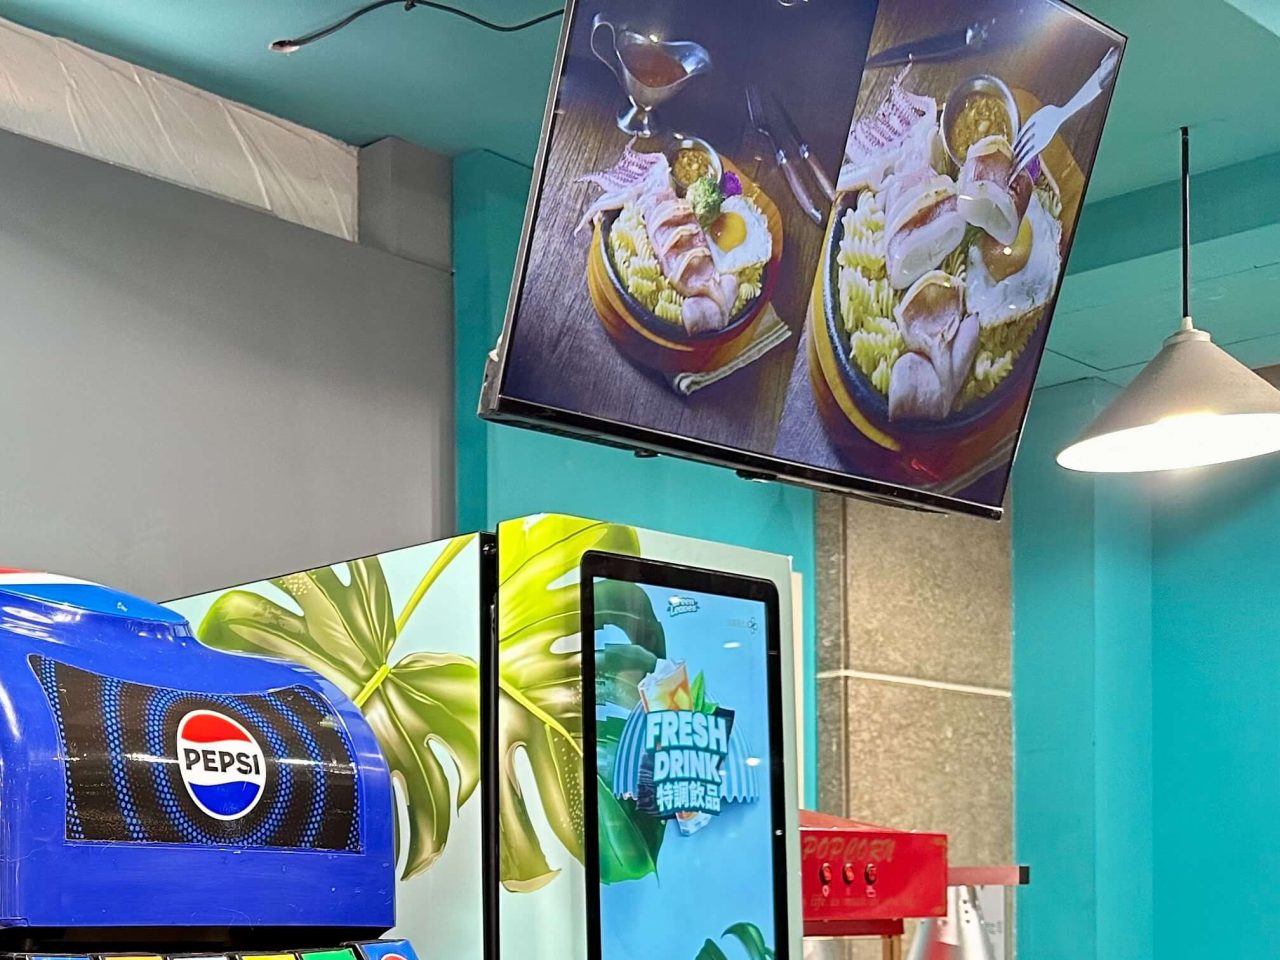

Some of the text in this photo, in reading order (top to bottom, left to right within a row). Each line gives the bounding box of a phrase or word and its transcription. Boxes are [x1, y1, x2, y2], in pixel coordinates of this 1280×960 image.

[645, 710, 728, 753] FRESH
[184, 748, 261, 775] PEPSI
[653, 750, 721, 783] DRINK
[656, 782, 721, 815] 特調飲品
[802, 835, 896, 863] POPCORN
